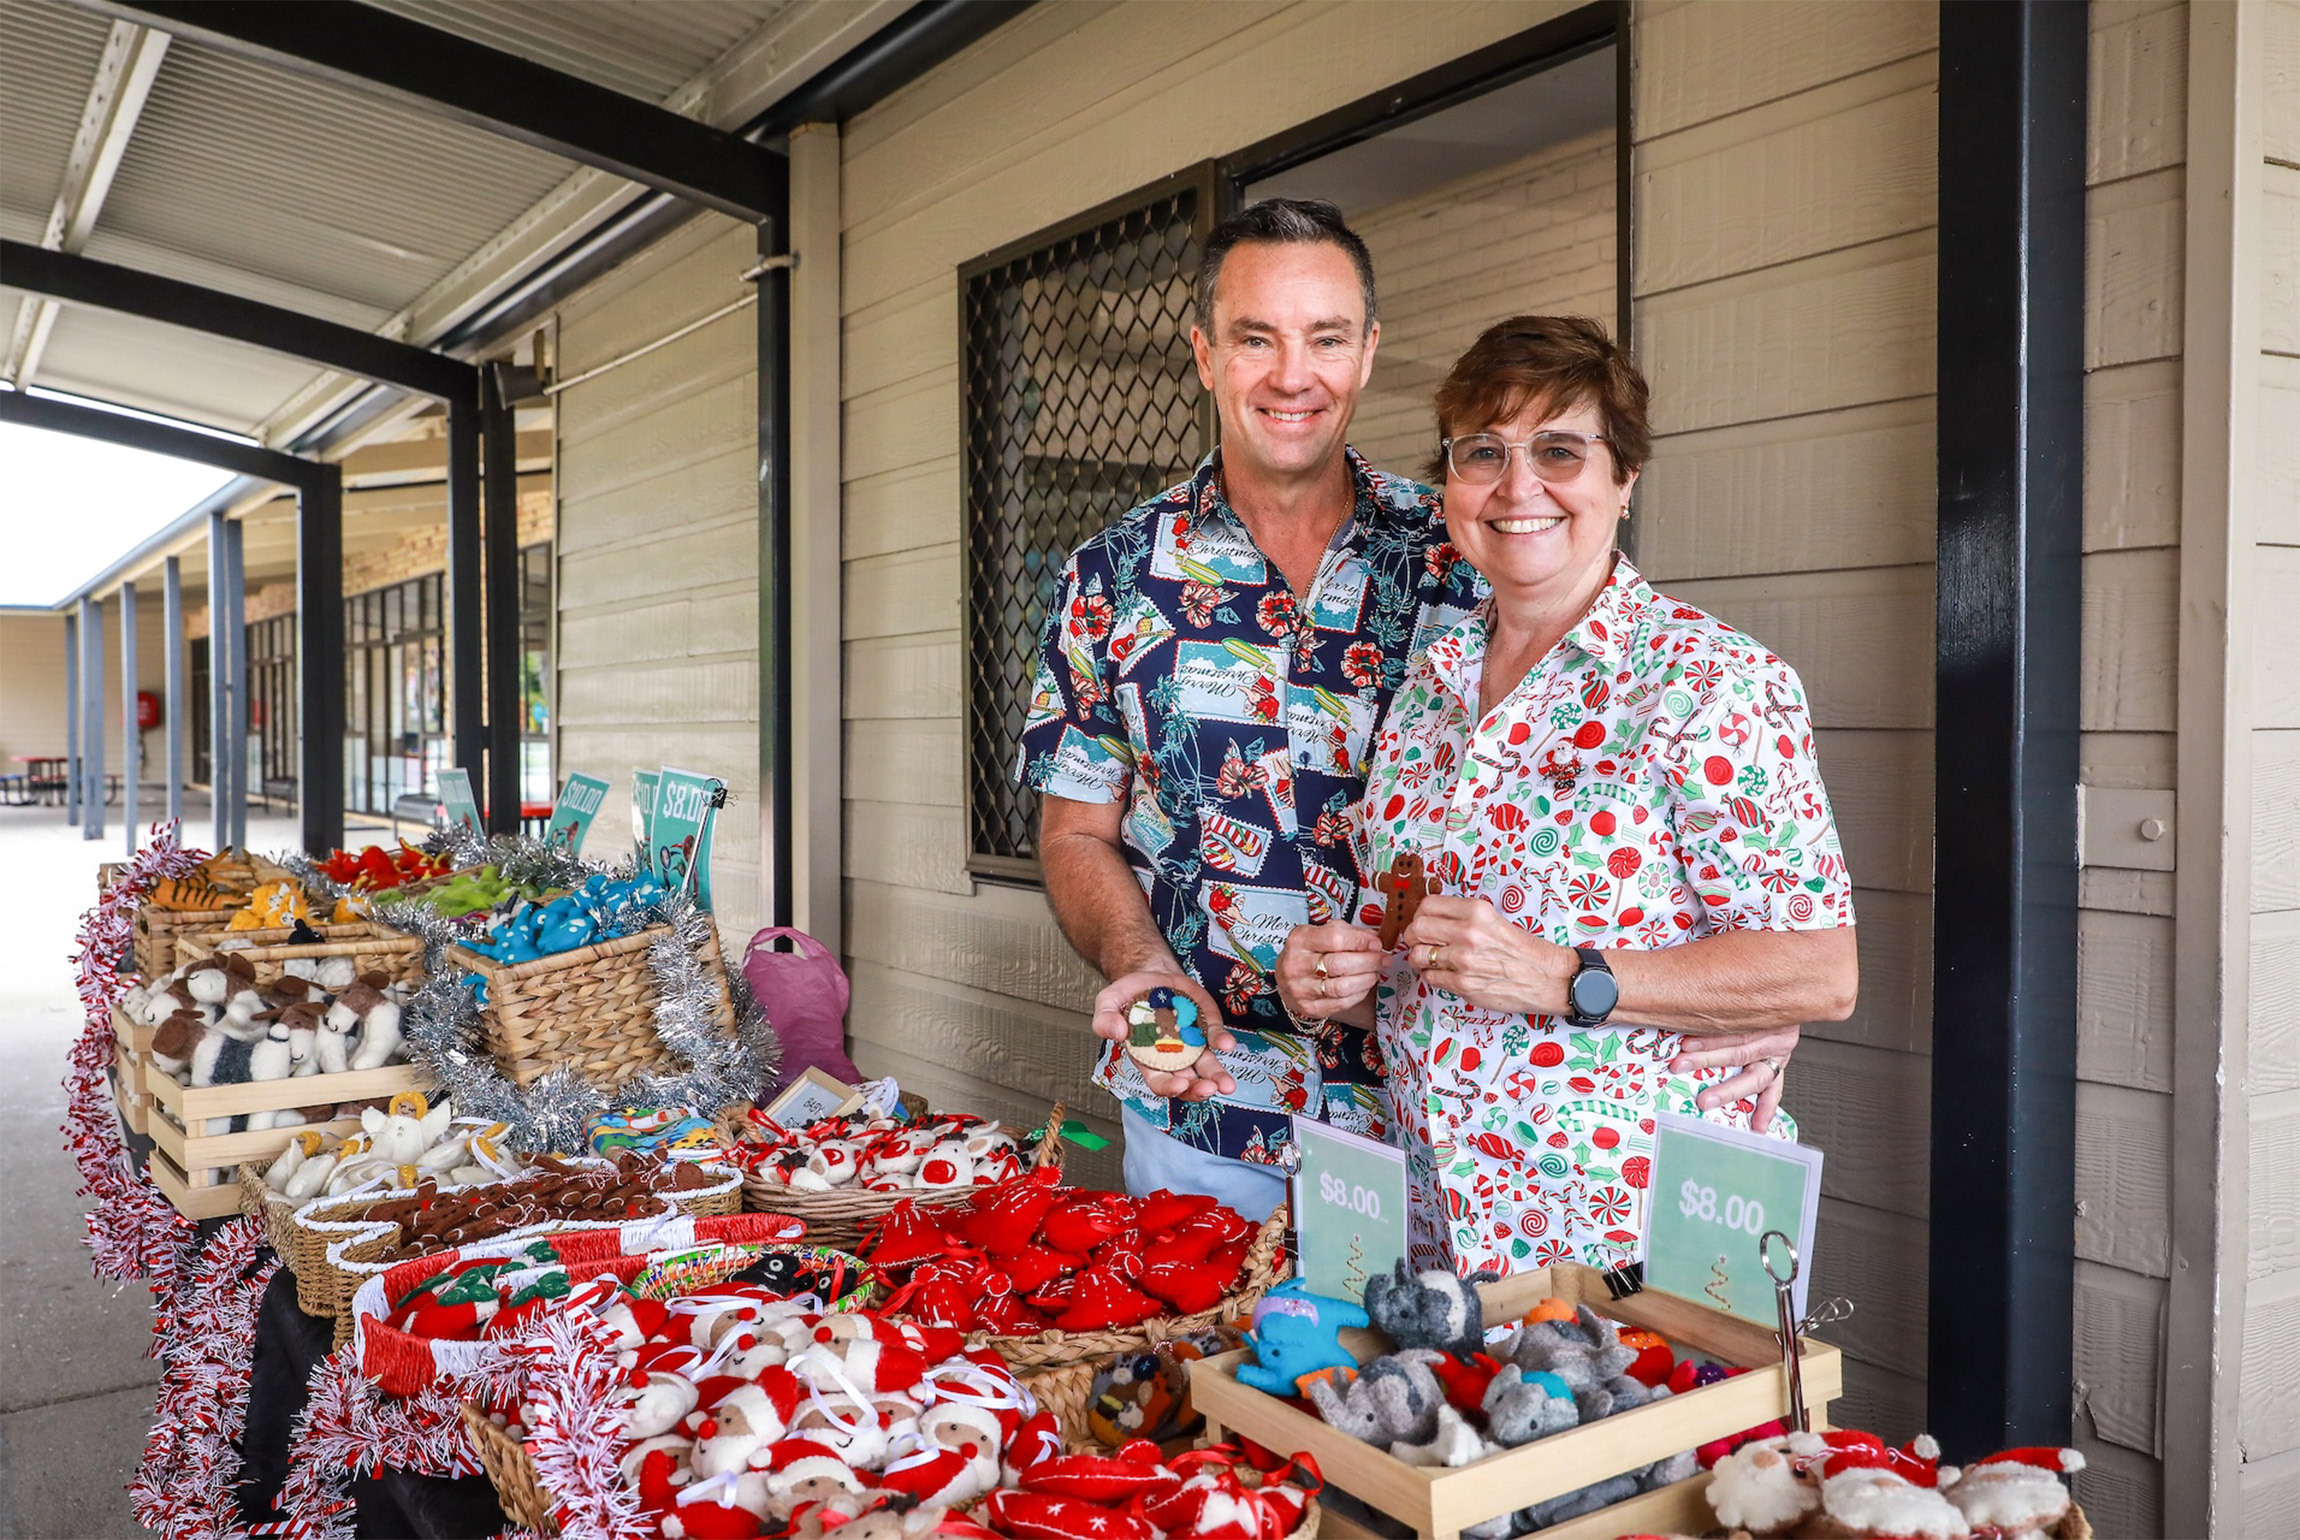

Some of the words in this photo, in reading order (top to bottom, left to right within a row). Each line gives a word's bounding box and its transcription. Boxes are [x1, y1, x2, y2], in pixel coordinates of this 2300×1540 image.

[1178, 665, 1261, 685] Christmas
[1182, 676, 1236, 698] Merry
[561, 780, 603, 815] $10.00
[1320, 1170, 1380, 1219] $8.00
[1679, 1178, 1764, 1235] $8.00
